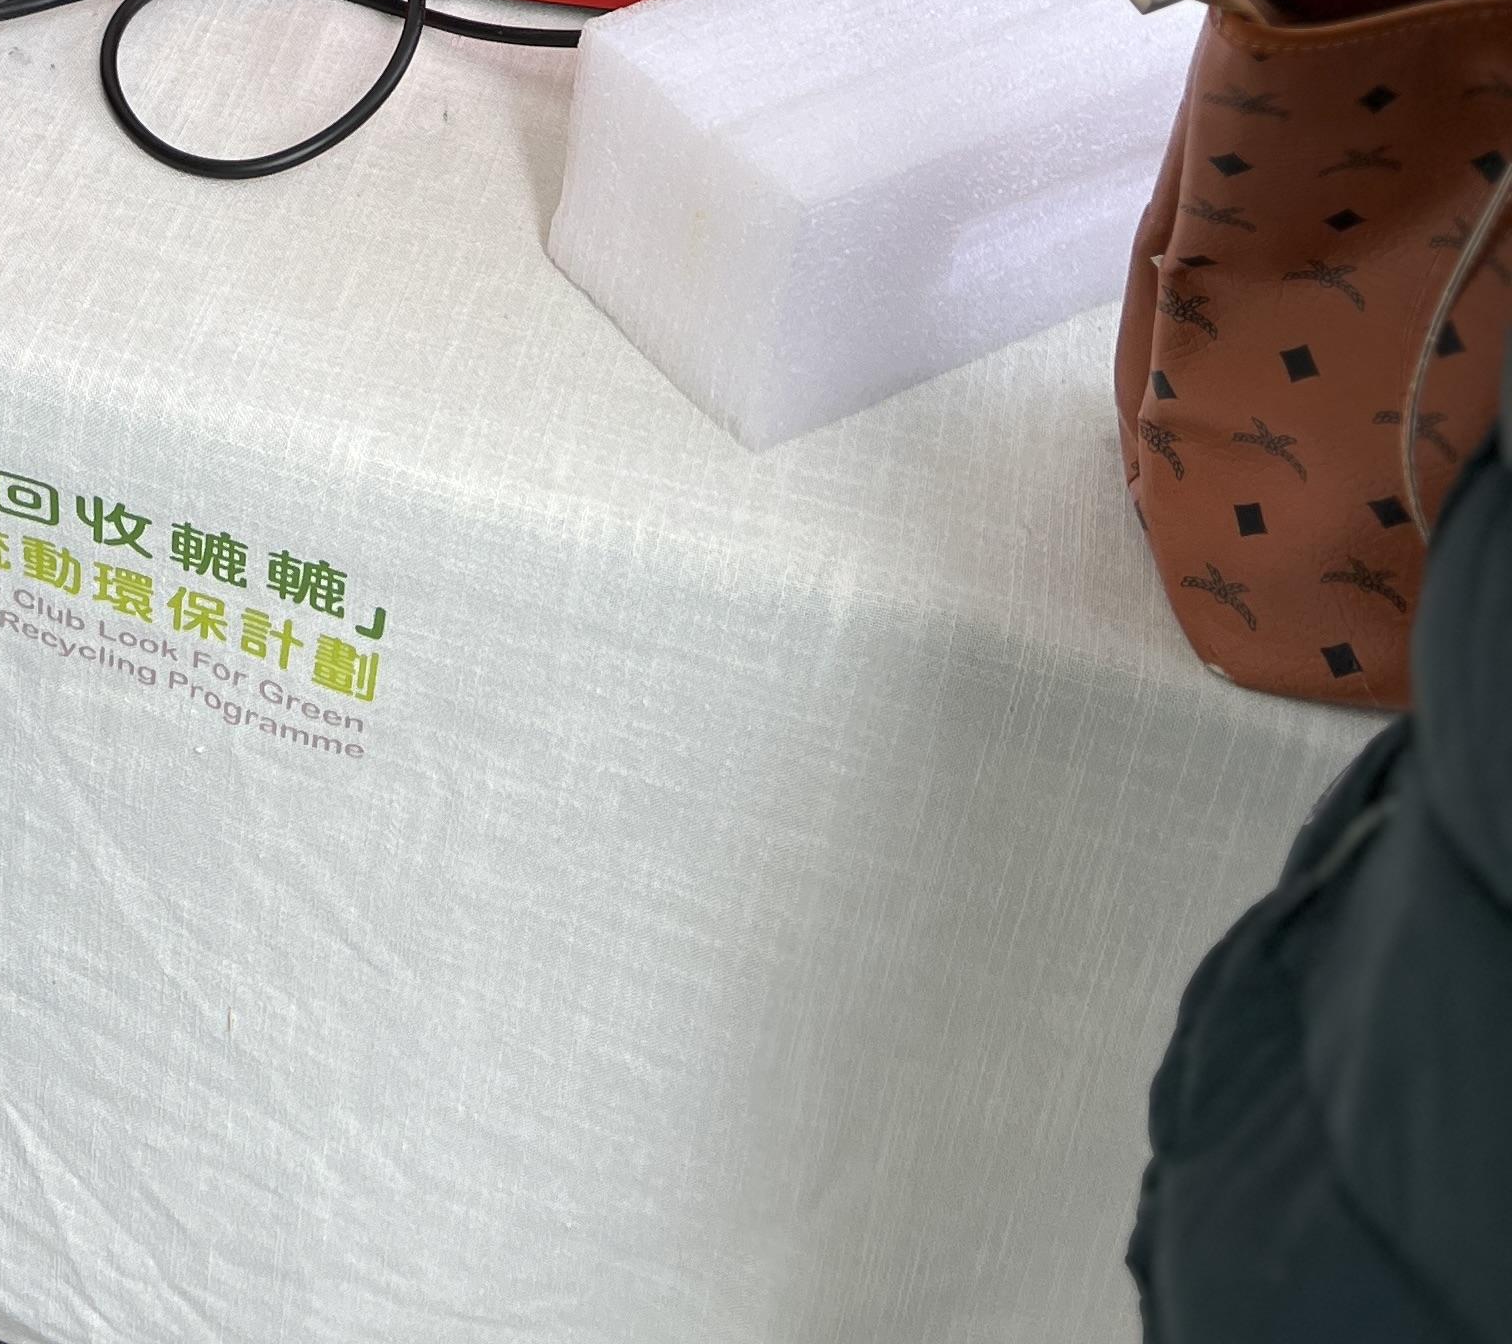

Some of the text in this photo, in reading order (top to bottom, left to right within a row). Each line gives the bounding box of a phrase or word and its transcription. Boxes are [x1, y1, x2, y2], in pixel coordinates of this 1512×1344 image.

[0, 610, 157, 686] Recycling
[169, 670, 365, 759] Programme
[13, 588, 85, 631] Club
[98, 620, 179, 662] Look
[192, 650, 249, 687] For
[258, 679, 364, 733] Green
